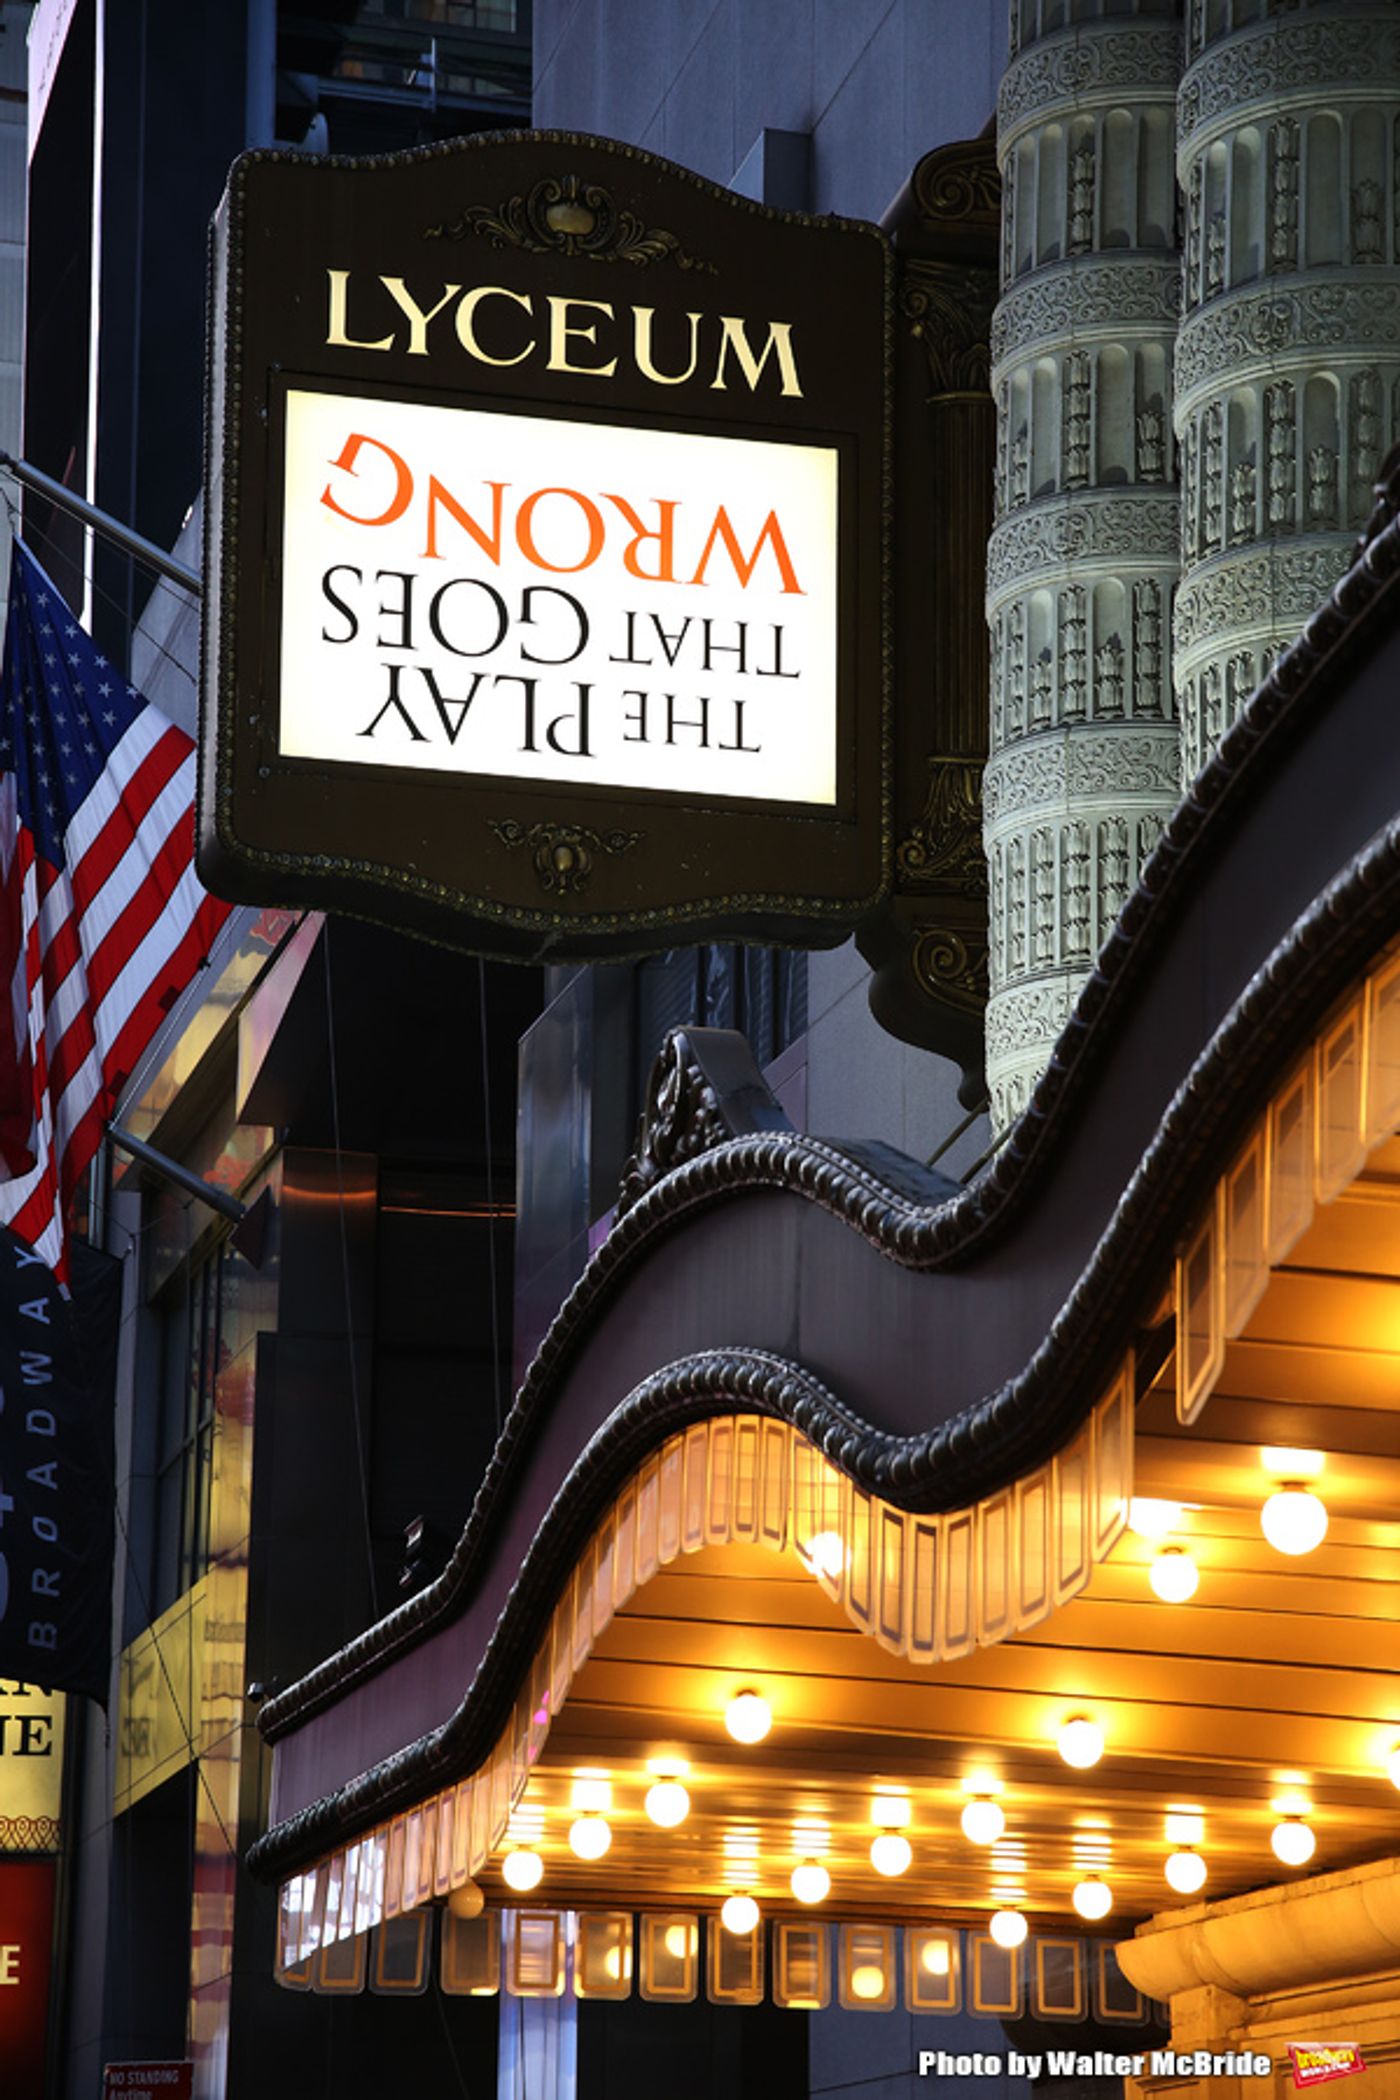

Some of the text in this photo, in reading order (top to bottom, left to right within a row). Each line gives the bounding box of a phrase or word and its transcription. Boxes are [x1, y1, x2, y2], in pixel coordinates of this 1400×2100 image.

[326, 270, 803, 398] LYCEUM
[319, 433, 808, 595] WRONG
[321, 564, 800, 678] THAT GOES
[357, 664, 761, 757] THE PLAY
[14, 1246, 61, 1650] BROADWAY
